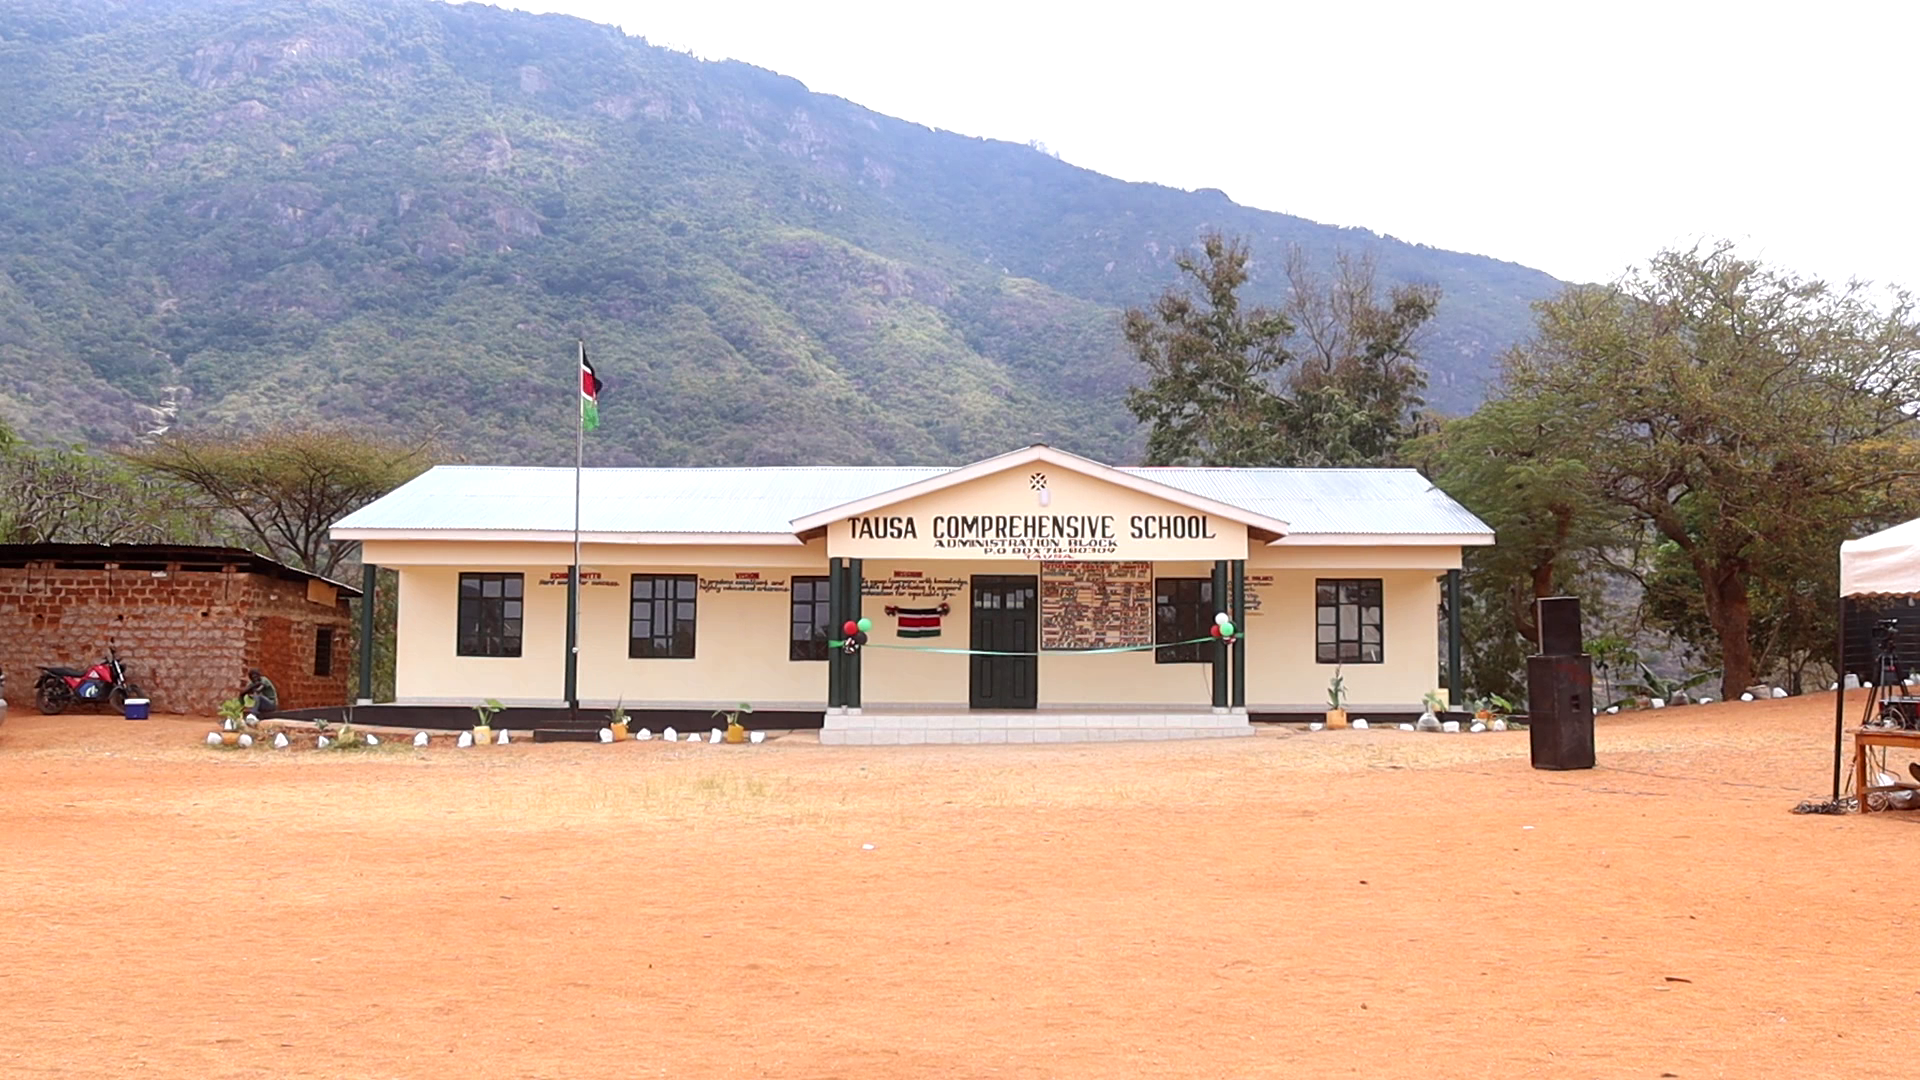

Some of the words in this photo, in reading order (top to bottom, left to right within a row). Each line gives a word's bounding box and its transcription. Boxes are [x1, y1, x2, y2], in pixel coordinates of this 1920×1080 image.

[848, 516, 917, 539] TAUSA
[933, 515, 1115, 539] COMPREHENSIVE
[1131, 515, 1216, 539] SCHOOL
[934, 539, 1060, 548] ADMINISTRATION
[1068, 539, 1118, 547] BLOCK
